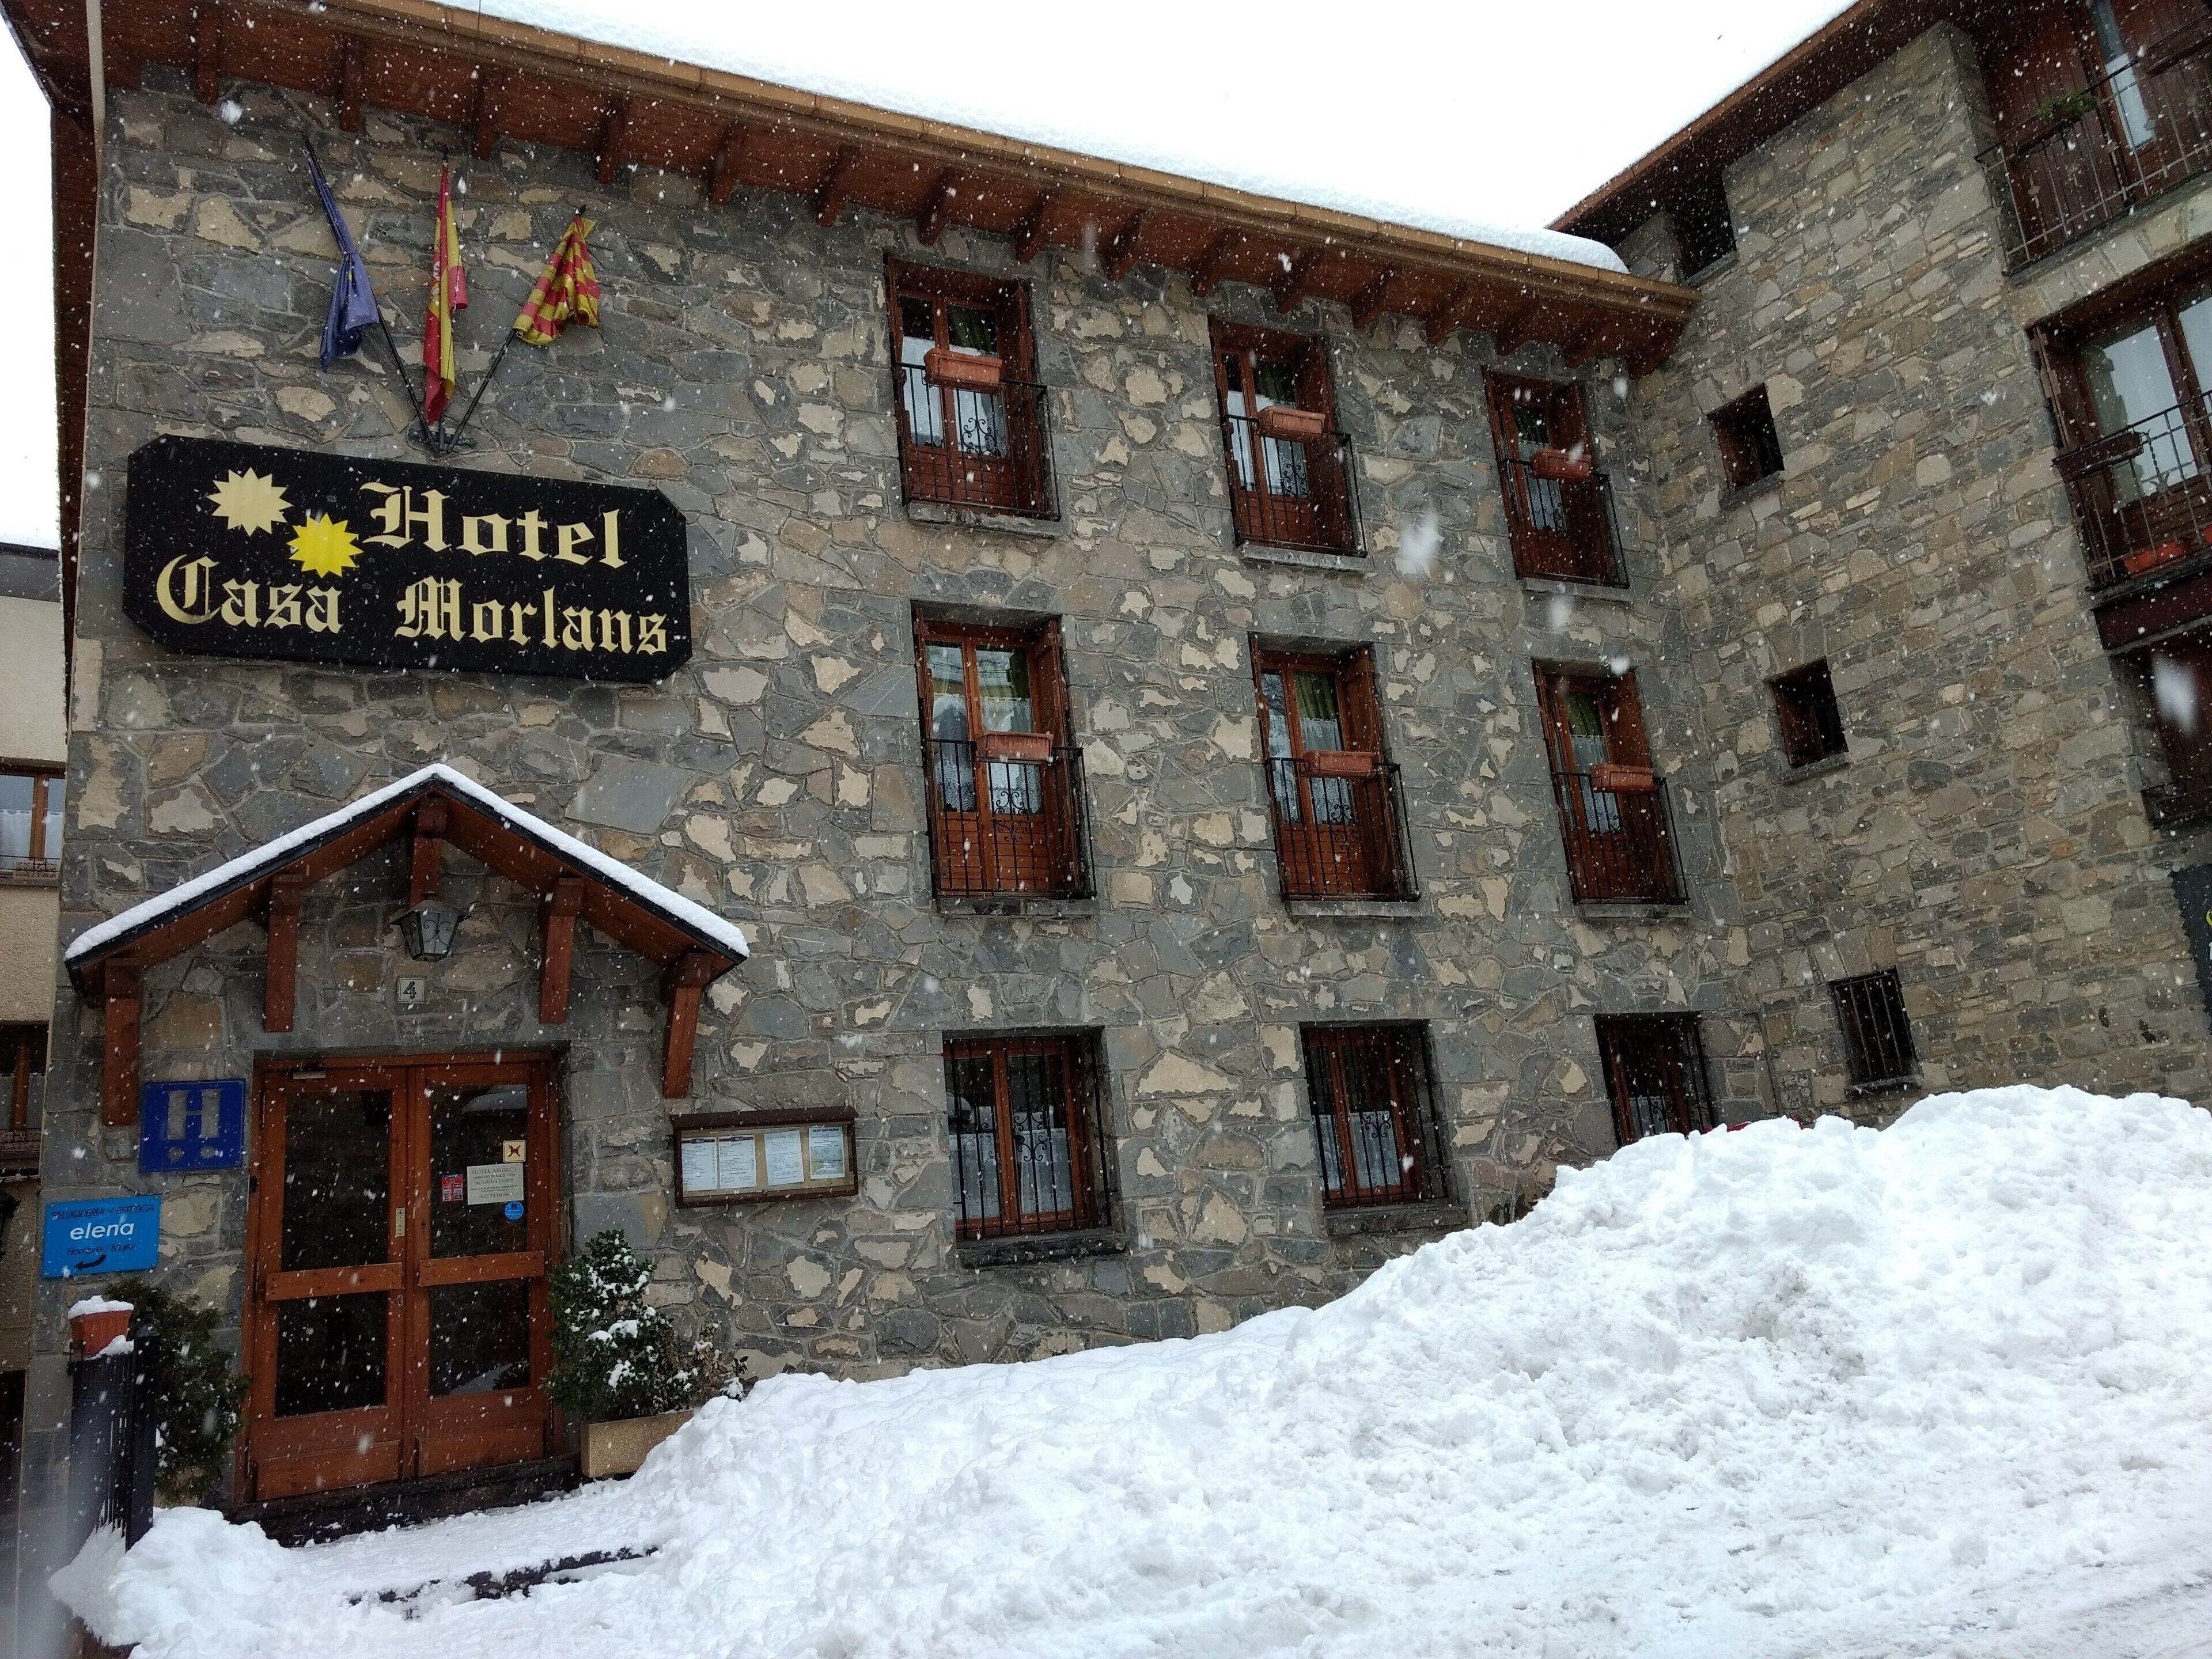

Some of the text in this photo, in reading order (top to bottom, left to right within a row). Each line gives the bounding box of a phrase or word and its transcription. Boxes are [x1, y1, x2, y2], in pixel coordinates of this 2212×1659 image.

[359, 482, 628, 569] Hotel
[156, 554, 668, 655] Casa Morlans
[403, 980, 416, 999] 4
[166, 1089, 222, 1141] H
[70, 1222, 135, 1240] elena
[67, 1247, 102, 1255] Hombre
[111, 1244, 136, 1252] Mujer
